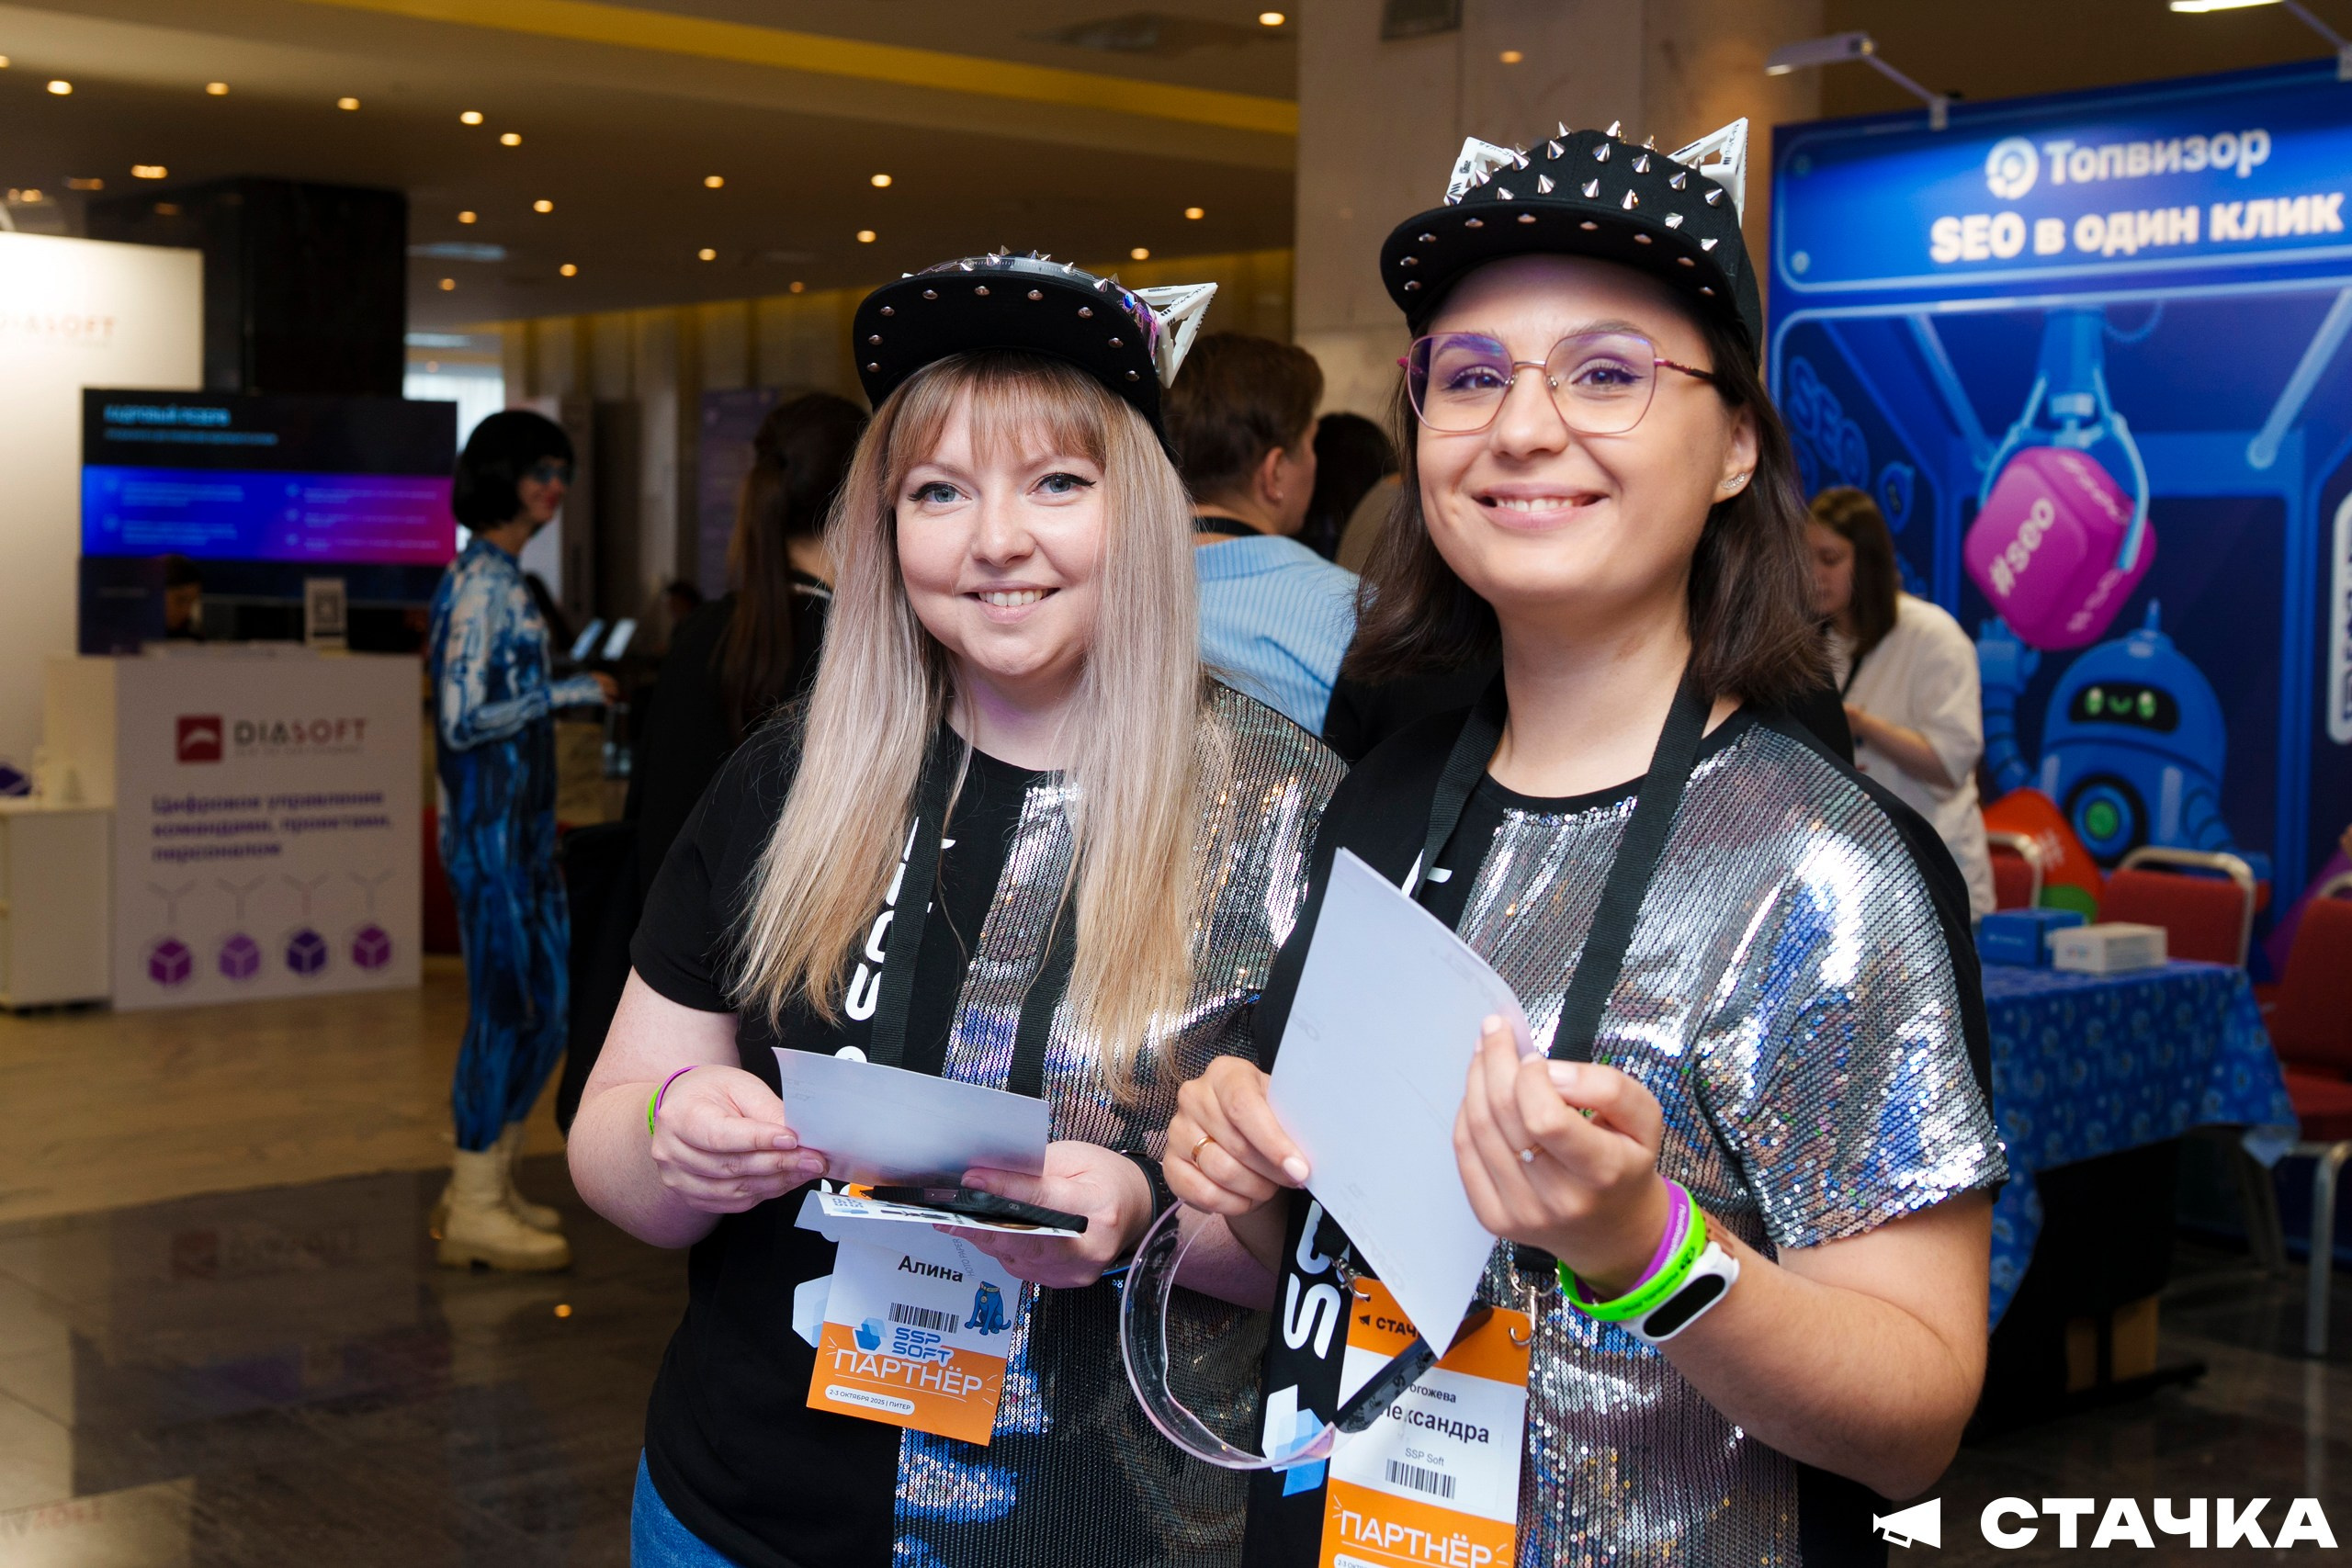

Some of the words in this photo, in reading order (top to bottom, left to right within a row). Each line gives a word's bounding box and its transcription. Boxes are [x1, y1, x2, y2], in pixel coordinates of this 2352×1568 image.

[2043, 129, 2271, 185] Топвизор
[1930, 211, 2026, 263] SEO
[2034, 218, 2065, 254] в
[2073, 207, 2199, 256] один
[2210, 193, 2344, 242] клик
[1989, 497, 2055, 599] #seo
[234, 717, 367, 746] DIASOFT
[898, 1255, 963, 1282] Алина
[895, 1326, 942, 1345] SSP
[1376, 1316, 1419, 1338] СТАЧ
[892, 1342, 951, 1362] SOFT
[834, 1348, 983, 1395] ПАРТНЁР
[840, 1391, 869, 1402] ОКТЯБРЯ
[870, 1397, 885, 1405] 2025
[888, 1401, 911, 1410] ПИТЕР
[1408, 1382, 1457, 1404] огожева
[1405, 1447, 1425, 1461] SSP
[1427, 1453, 1444, 1467] Soft
[1340, 1509, 1493, 1568] ПАРТНЁР
